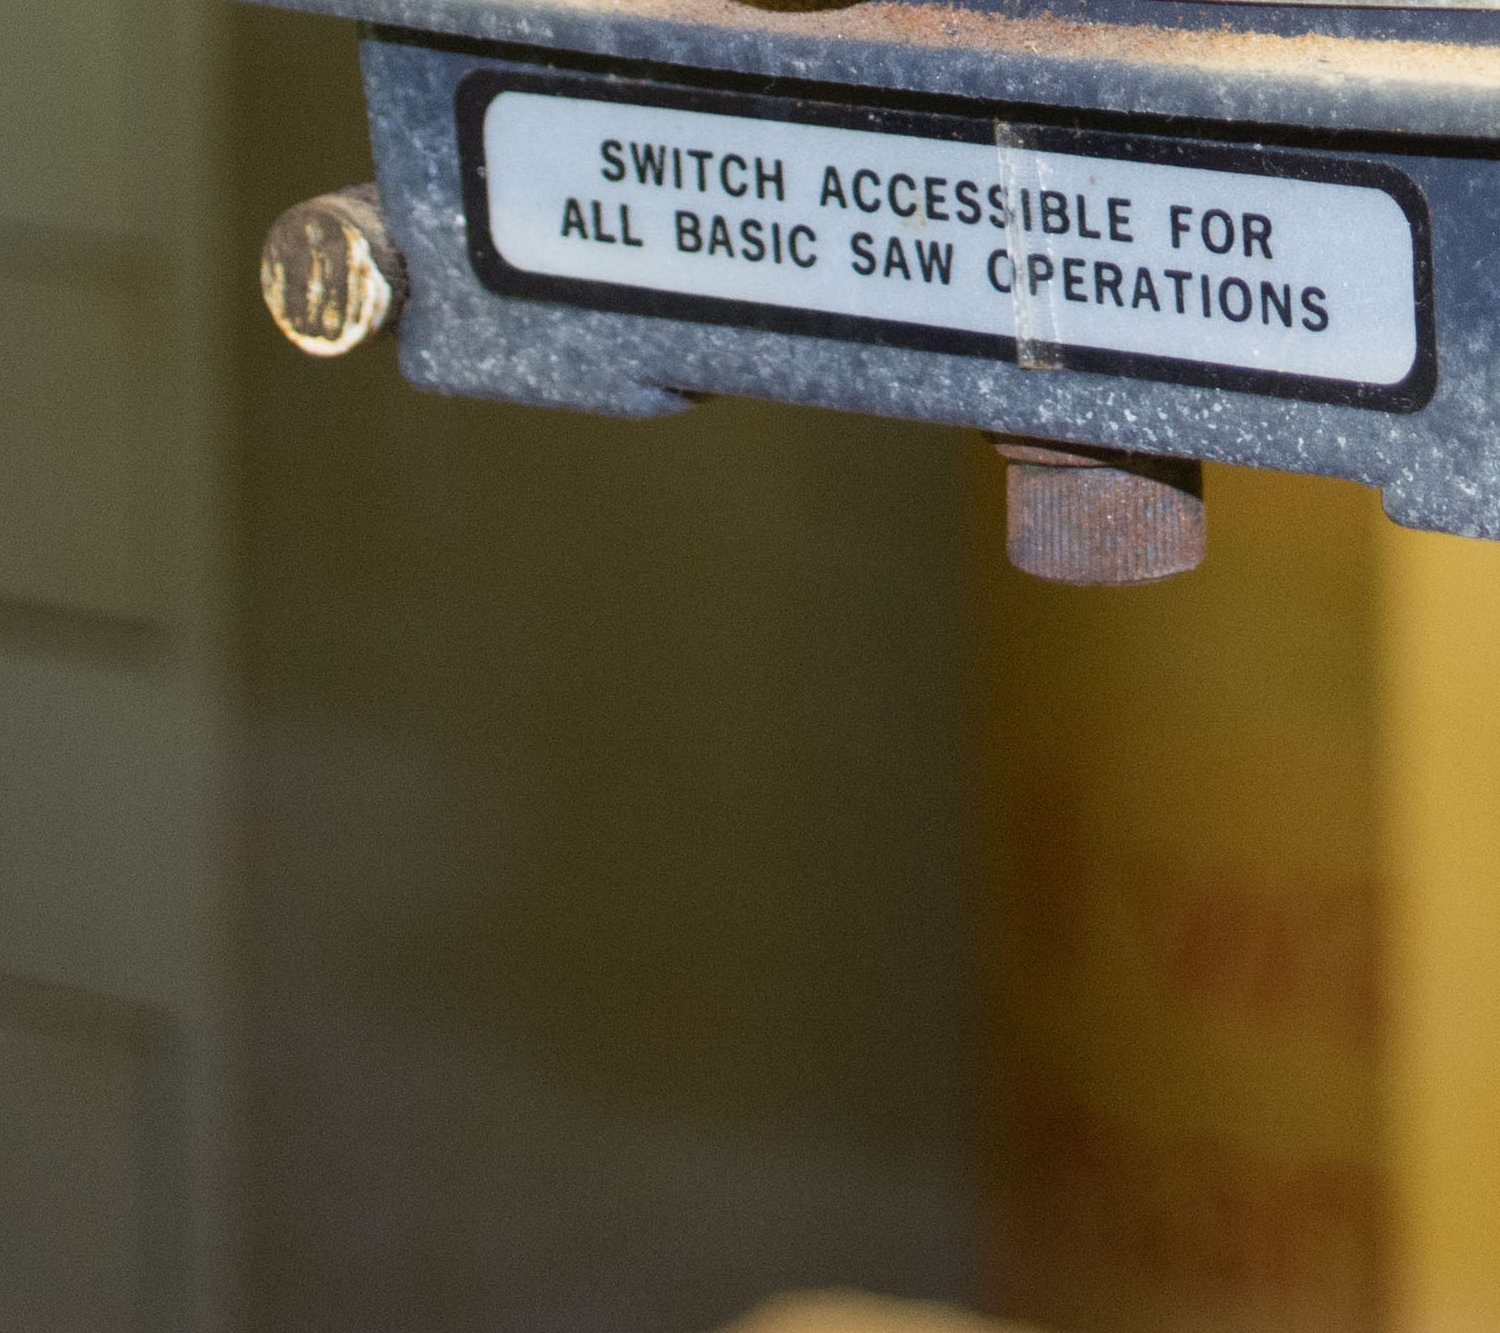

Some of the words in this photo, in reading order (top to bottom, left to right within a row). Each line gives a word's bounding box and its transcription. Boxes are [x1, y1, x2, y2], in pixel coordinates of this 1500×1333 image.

[599, 139, 785, 202] SWITCH
[819, 163, 1136, 245] ACCESSIBLE
[1169, 204, 1273, 260] FOR
[560, 197, 644, 248] ALL
[674, 209, 818, 270] BASIC
[849, 231, 954, 286] SAW
[986, 247, 1331, 333] OPERATIONS
